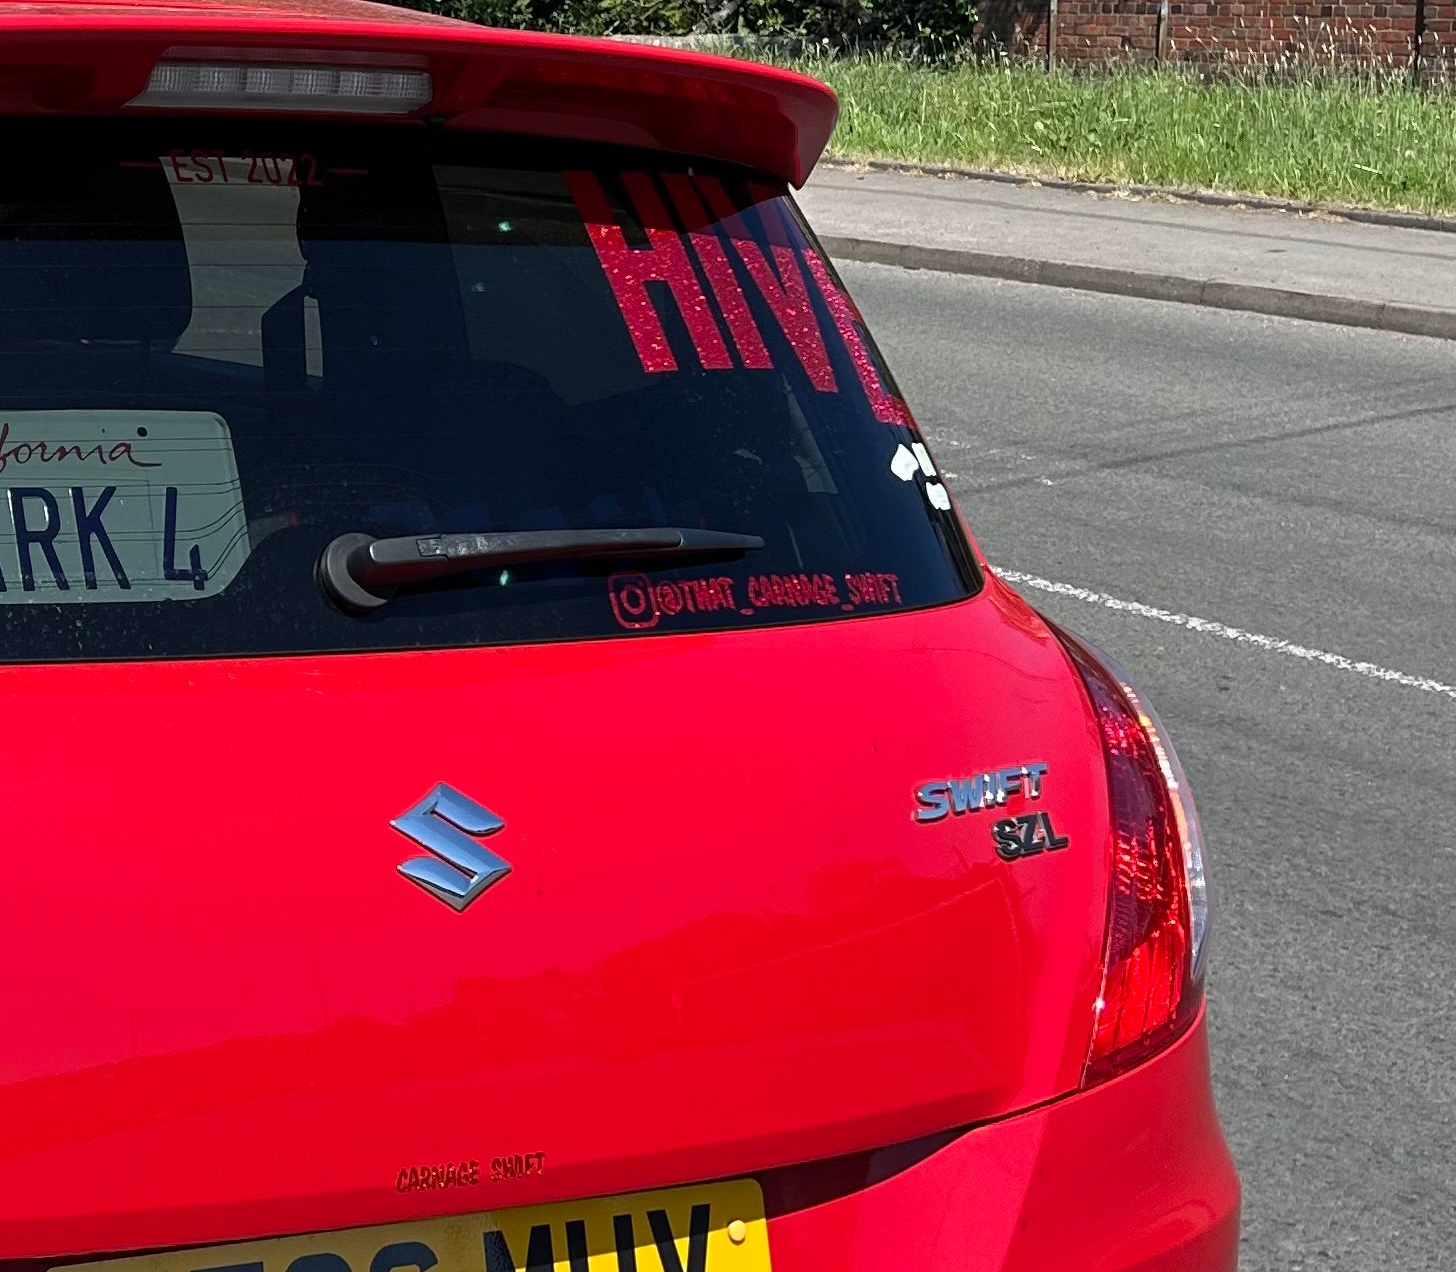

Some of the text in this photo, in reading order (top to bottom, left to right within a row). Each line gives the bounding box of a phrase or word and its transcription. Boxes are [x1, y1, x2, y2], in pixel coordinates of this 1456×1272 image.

[166, 146, 325, 186] EST 2022
[163, 486, 208, 591] 4
[915, 762, 1048, 823] SWIFT
[397, 1160, 480, 1193] CARNAGE
